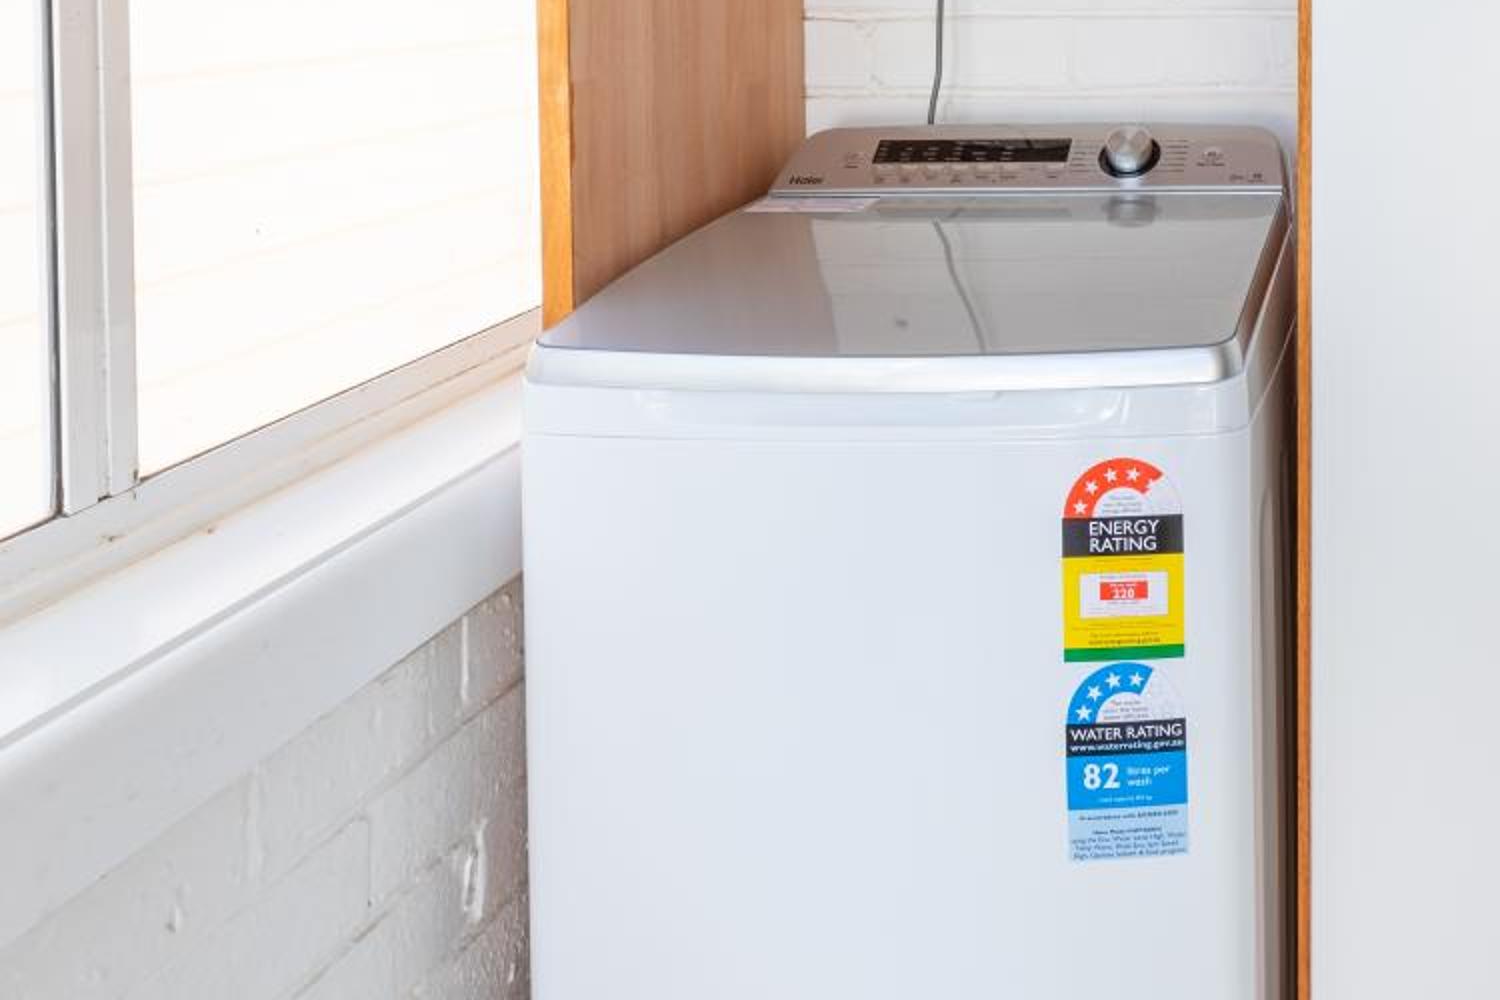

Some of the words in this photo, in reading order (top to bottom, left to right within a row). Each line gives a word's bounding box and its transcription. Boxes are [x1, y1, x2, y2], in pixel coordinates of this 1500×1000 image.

[1089, 520, 1159, 536] ENERGY
[1089, 536, 1157, 553] RATING
[1070, 727, 1122, 742] WATER
[1127, 723, 1183, 739] RATING
[1083, 762, 1120, 790] 82
[1153, 765, 1170, 776] per
